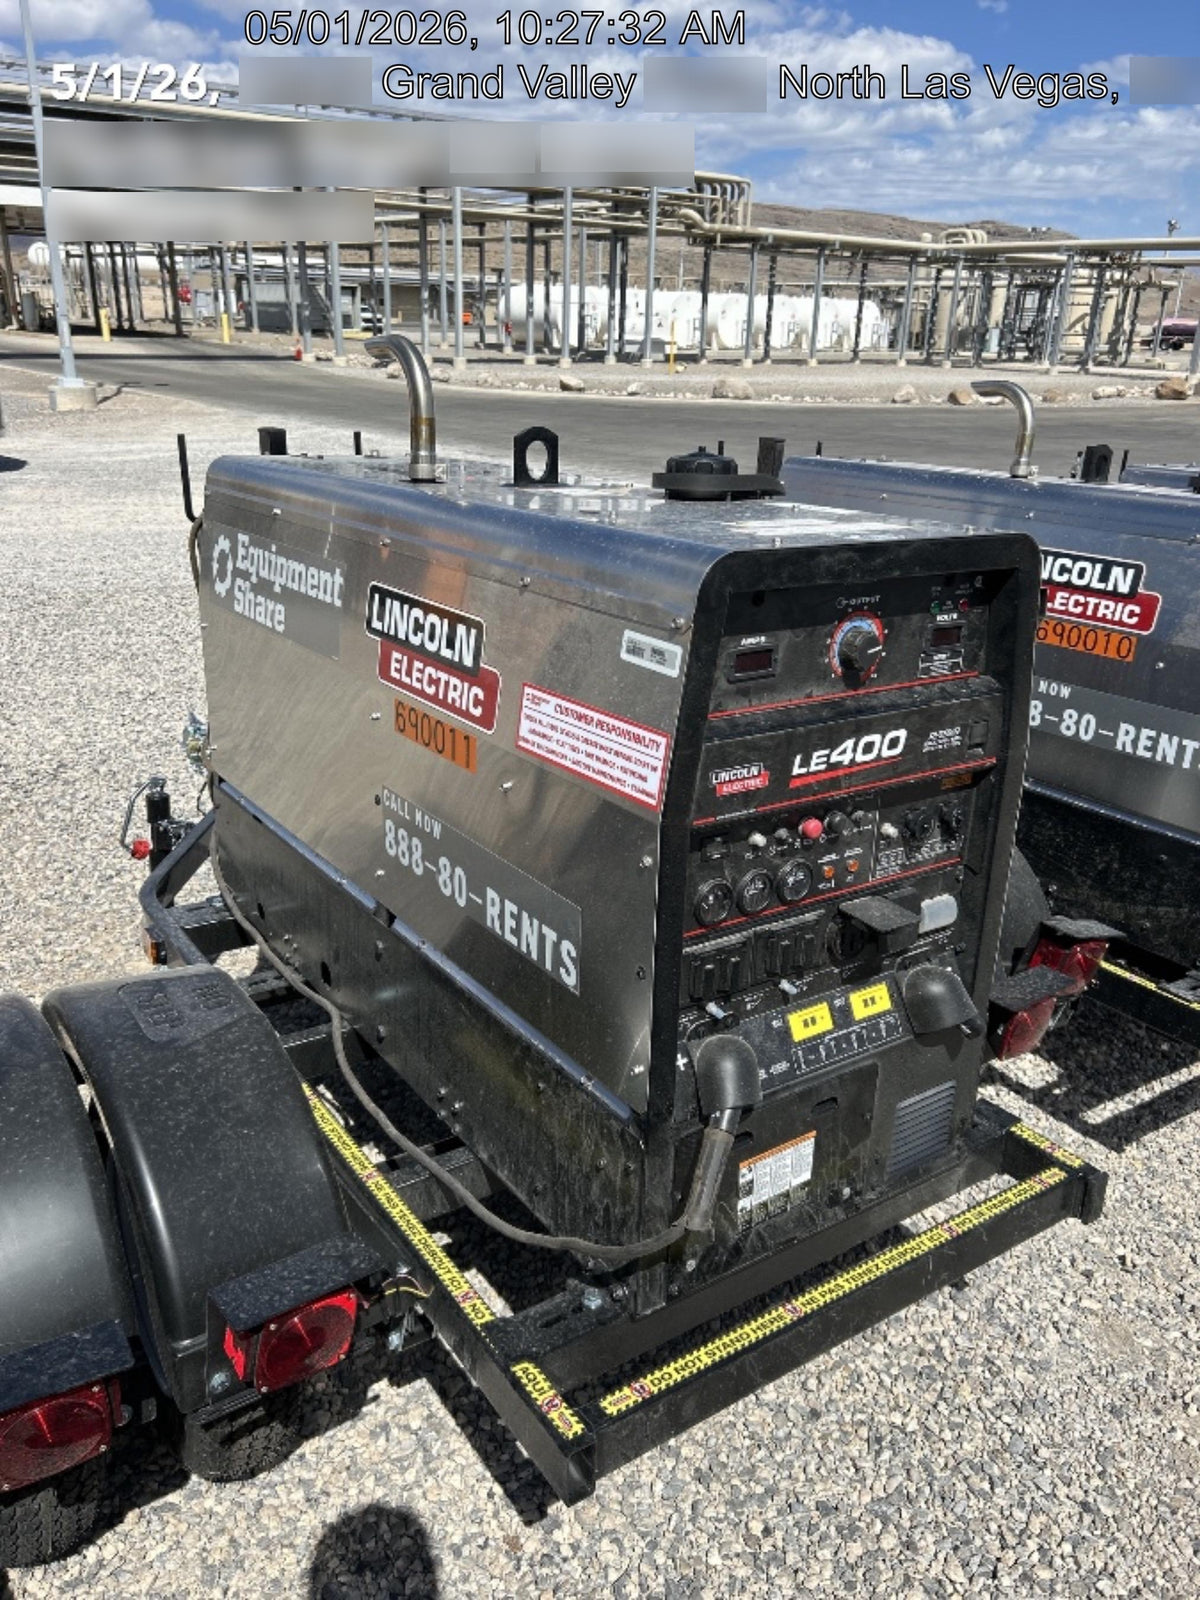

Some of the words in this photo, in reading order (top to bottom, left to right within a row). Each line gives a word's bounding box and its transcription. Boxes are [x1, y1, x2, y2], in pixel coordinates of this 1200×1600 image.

[236, 533, 344, 608] Equipment
[234, 577, 286, 633] Share
[371, 592, 478, 667] LINCOLN
[1036, 620, 1133, 659] 690010
[389, 650, 485, 717] ELECTRIC
[1038, 680, 1071, 699] NOW
[394, 700, 471, 769] 690011
[791, 728, 908, 776] LE400
[1029, 699, 1200, 769] 8-80-RENT
[384, 789, 410, 820] CALL
[415, 808, 442, 840] NOW
[385, 819, 577, 987] 888-80-RENTS
[469, 1302, 486, 1320] NO
[649, 1371, 674, 1388] DO
[674, 1354, 702, 1376] NOT
[703, 1332, 751, 1359] STAND
[752, 1313, 788, 1336] HERE
[820, 1283, 845, 1299] PAS
[843, 1262, 881, 1285] TENEZ
[882, 1240, 927, 1267] DEBOUT
[519, 1366, 549, 1397] AQUI
